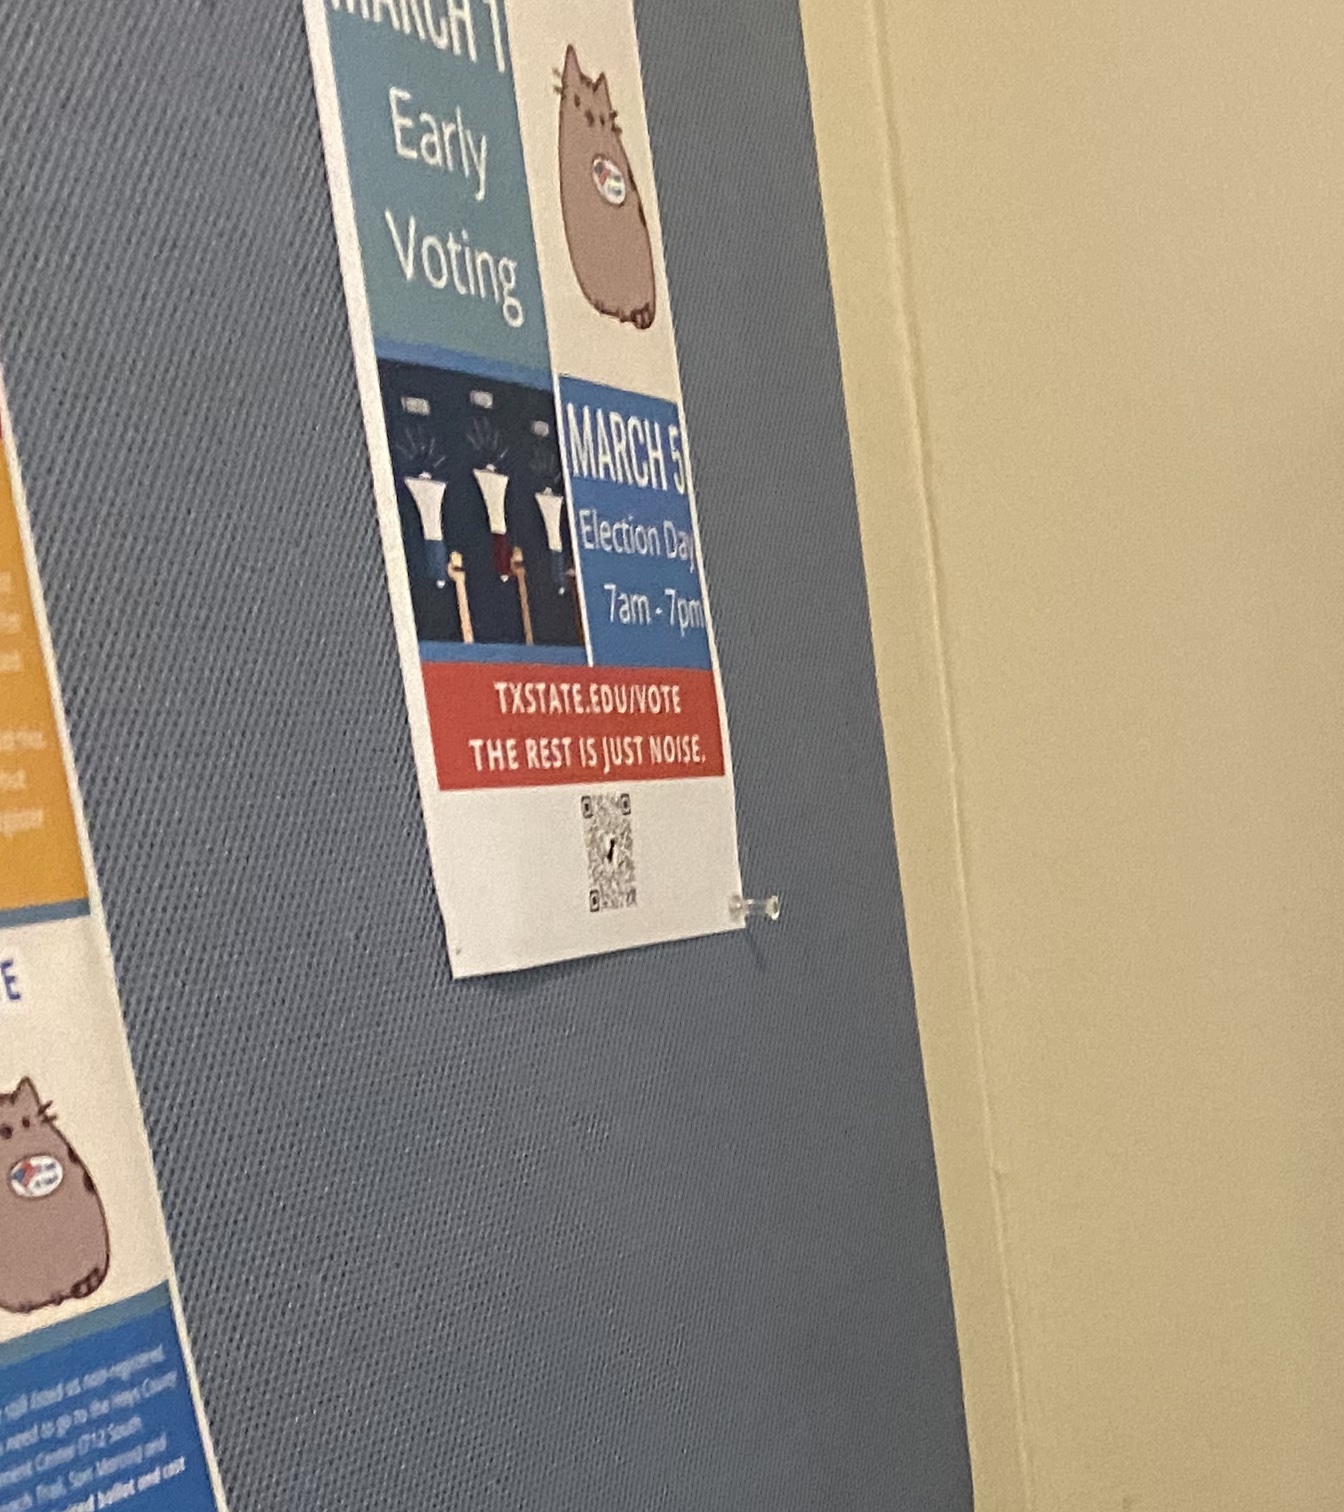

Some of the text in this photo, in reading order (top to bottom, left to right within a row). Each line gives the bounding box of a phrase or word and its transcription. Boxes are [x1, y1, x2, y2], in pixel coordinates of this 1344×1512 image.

[389, 86, 488, 200] Early
[385, 207, 524, 327] Voting
[565, 402, 687, 495] MARCH 5
[579, 508, 697, 574] Election Day
[604, 583, 651, 627] 7am
[665, 588, 705, 638] 7pm
[494, 680, 682, 716] TXSTATE.EDU/VOTE
[468, 733, 706, 774] THE REST IS JUST NOISE.
